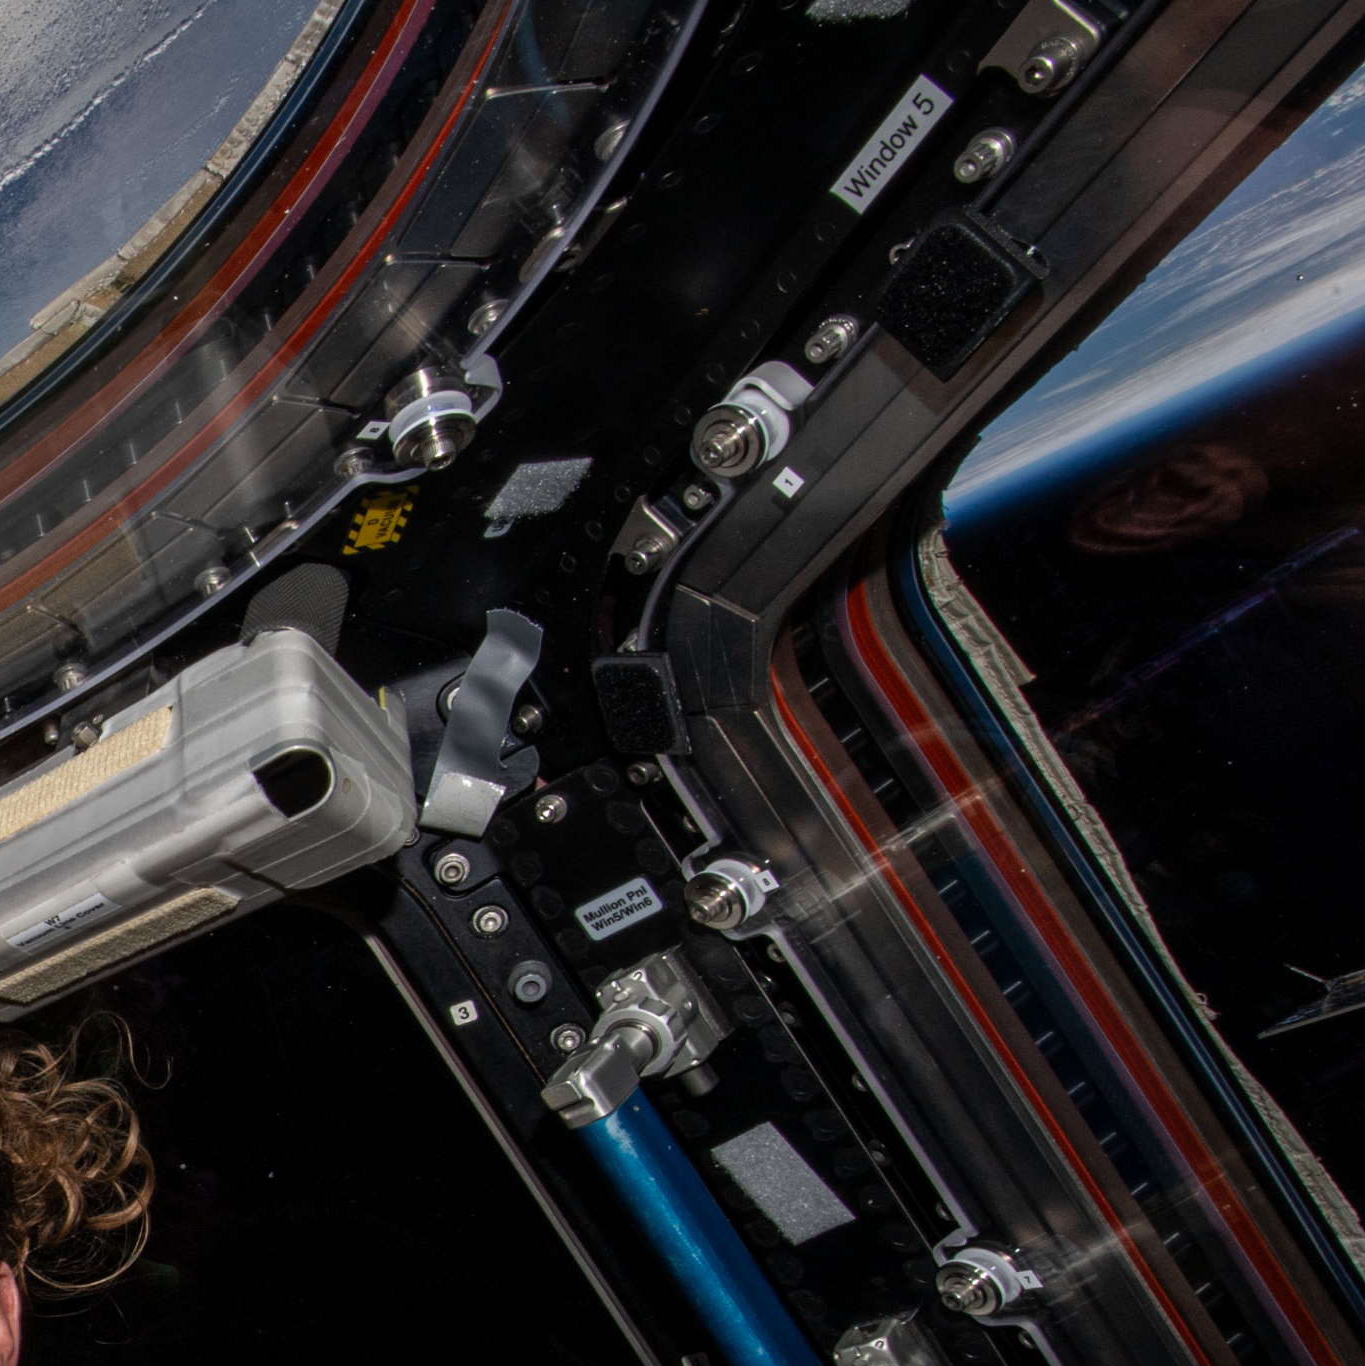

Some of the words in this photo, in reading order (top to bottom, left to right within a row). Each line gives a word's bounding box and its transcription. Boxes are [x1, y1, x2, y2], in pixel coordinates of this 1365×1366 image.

[844, 114, 918, 198] Window
[911, 92, 935, 116] 5
[44, 915, 61, 926] W7
[582, 893, 628, 925] Mullion
[625, 885, 649, 905] Pnl
[590, 896, 654, 932] Win5/Win6
[16, 927, 57, 948] Vacuum
[54, 917, 77, 930] Line
[76, 902, 105, 919] Cover
[457, 1006, 470, 1020] 3
